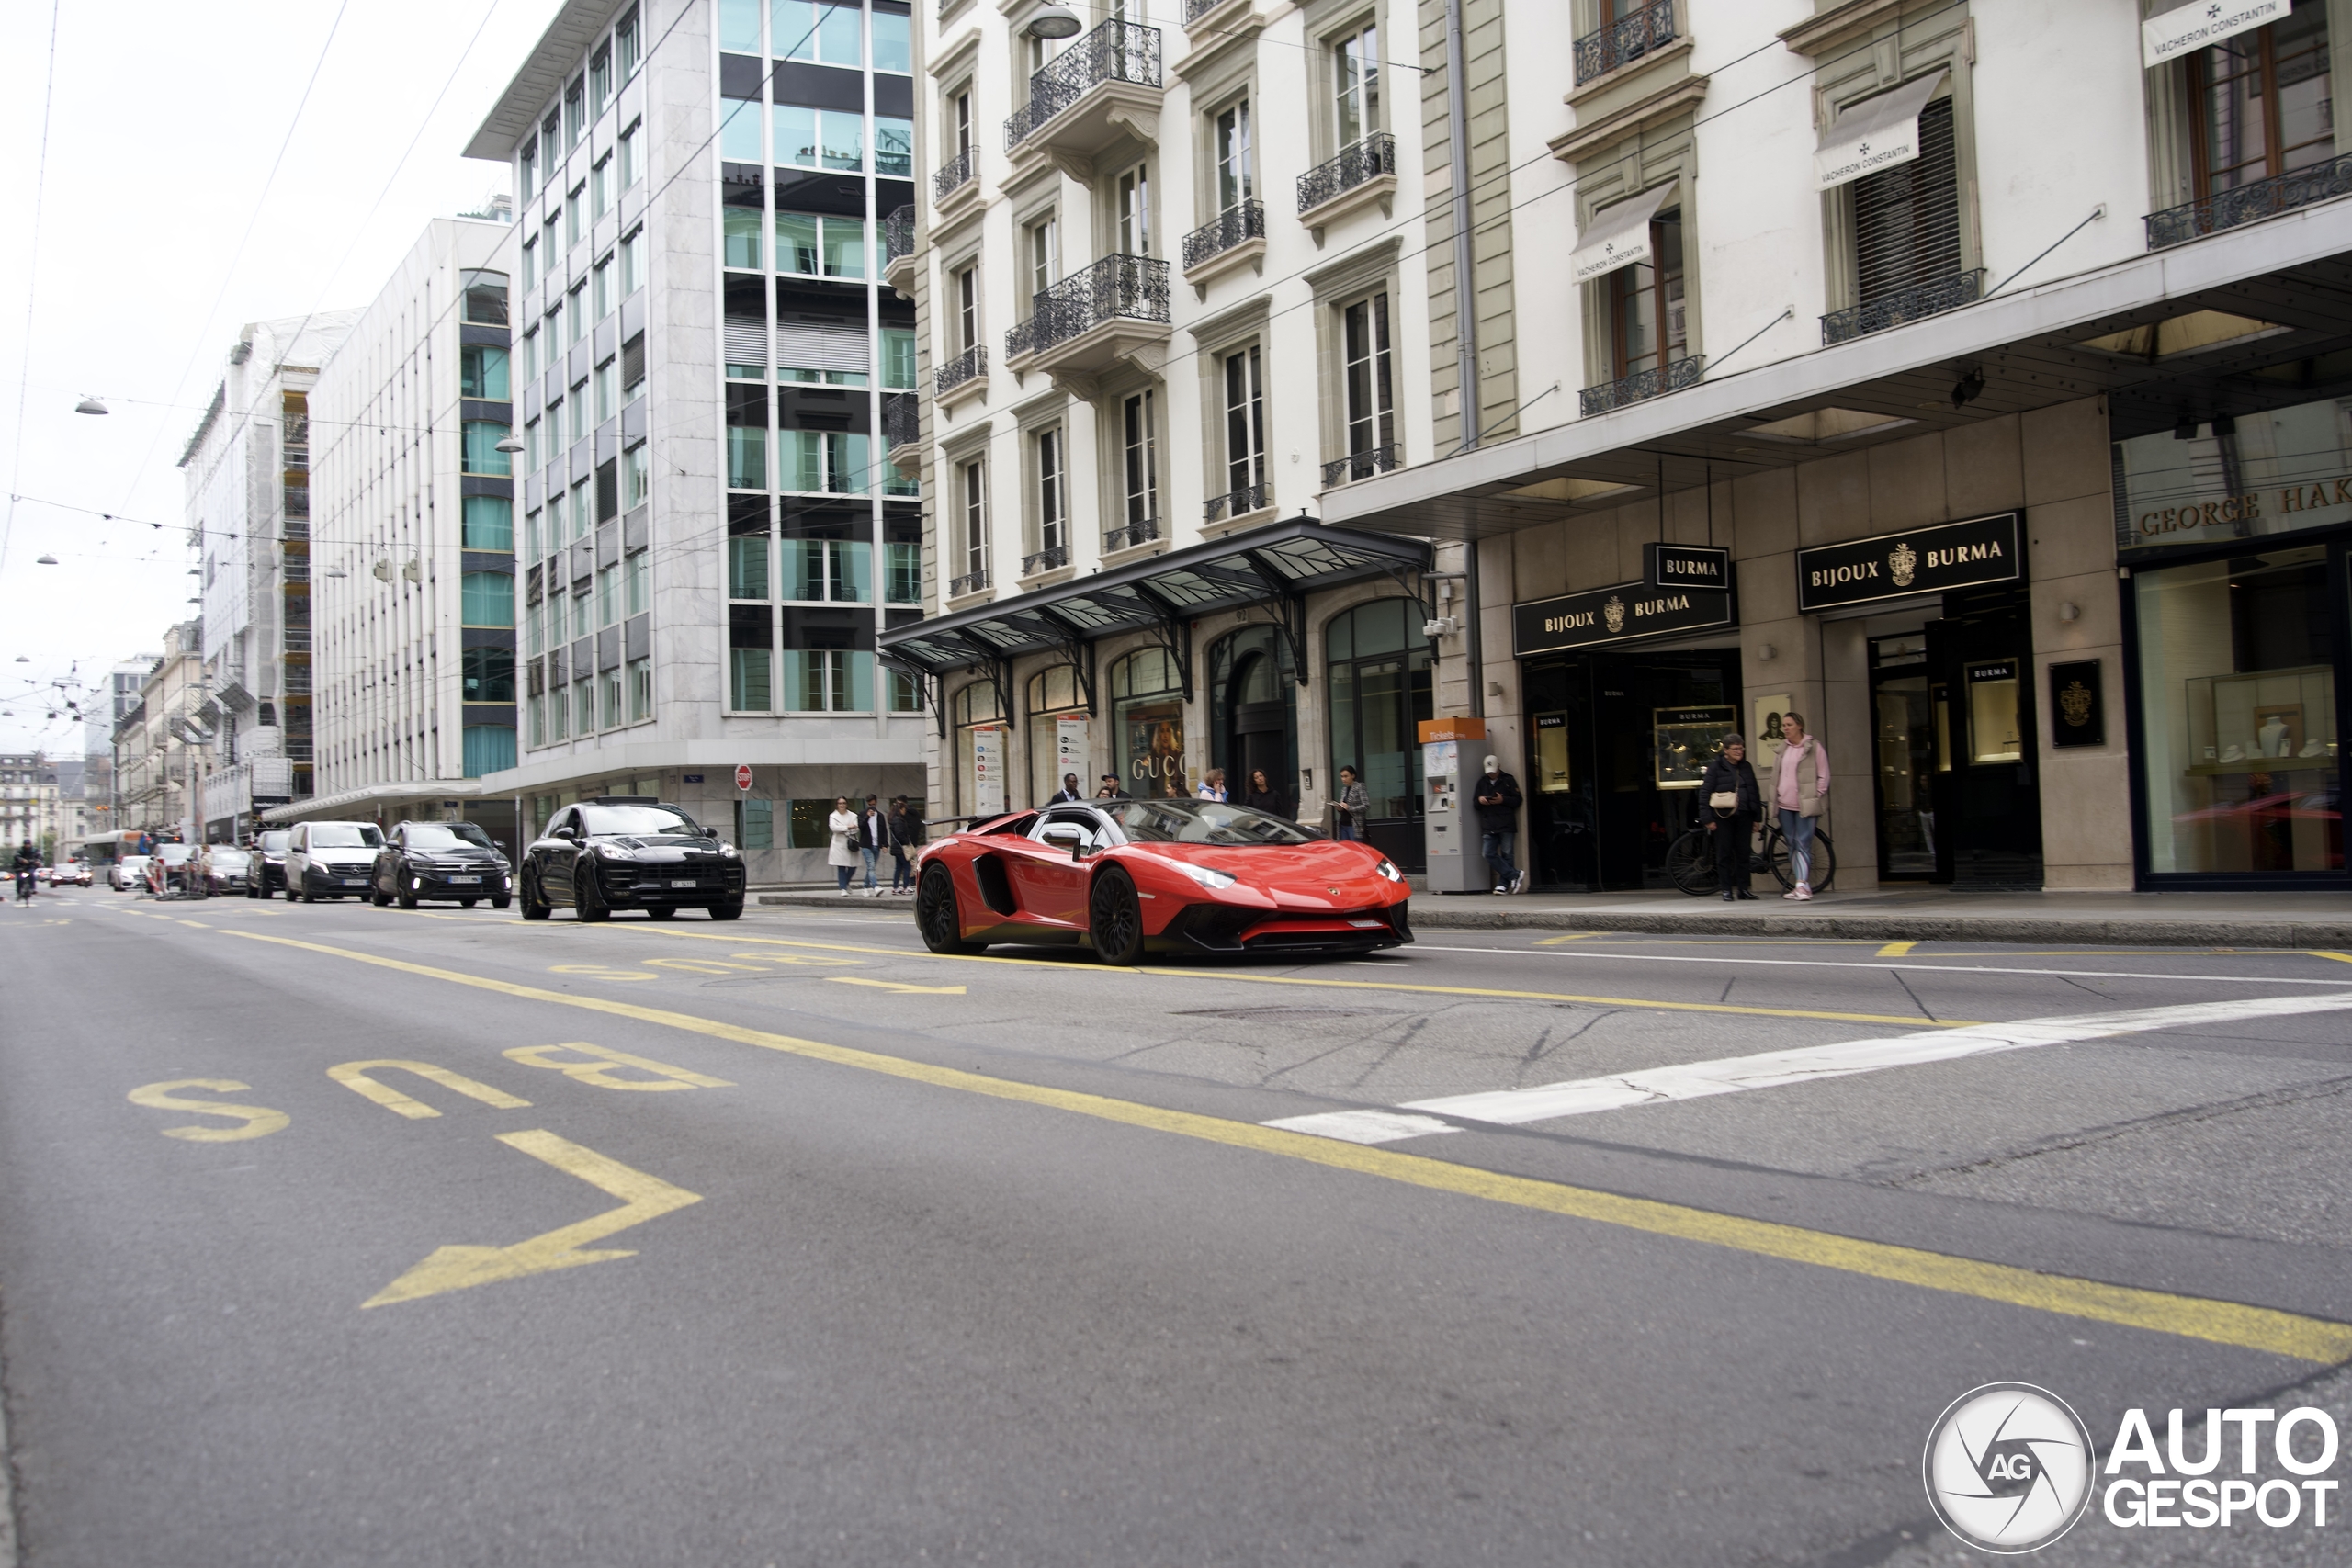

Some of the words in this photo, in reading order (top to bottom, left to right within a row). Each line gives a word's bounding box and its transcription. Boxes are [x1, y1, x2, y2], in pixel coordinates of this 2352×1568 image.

[2154, 28, 2209, 55] VACHERON
[2211, 1, 2277, 35] CONSTANTIN
[1821, 162, 1860, 183] VACHERON
[1861, 144, 1910, 169] CONSTANTIN
[1577, 260, 1608, 276] VACHERON
[1609, 244, 1644, 265] CONSTANTIN
[2139, 493, 2259, 536] GEORGE
[1666, 559, 1718, 576] BURMA
[1811, 561, 1879, 587] BIJOUX
[1927, 541, 2003, 568] BURMA
[1236, 609, 1247, 623] 92
[1544, 611, 1595, 633] BIJOUX
[1634, 594, 1690, 617] BURMA
[1974, 667, 2008, 678] BURMA
[1429, 730, 1455, 741] Tickets
[1540, 716, 1561, 726] BURMA
[738, 773, 751, 782] STOP
[548, 952, 867, 981] BUS
[128, 1042, 739, 1143] BUS
